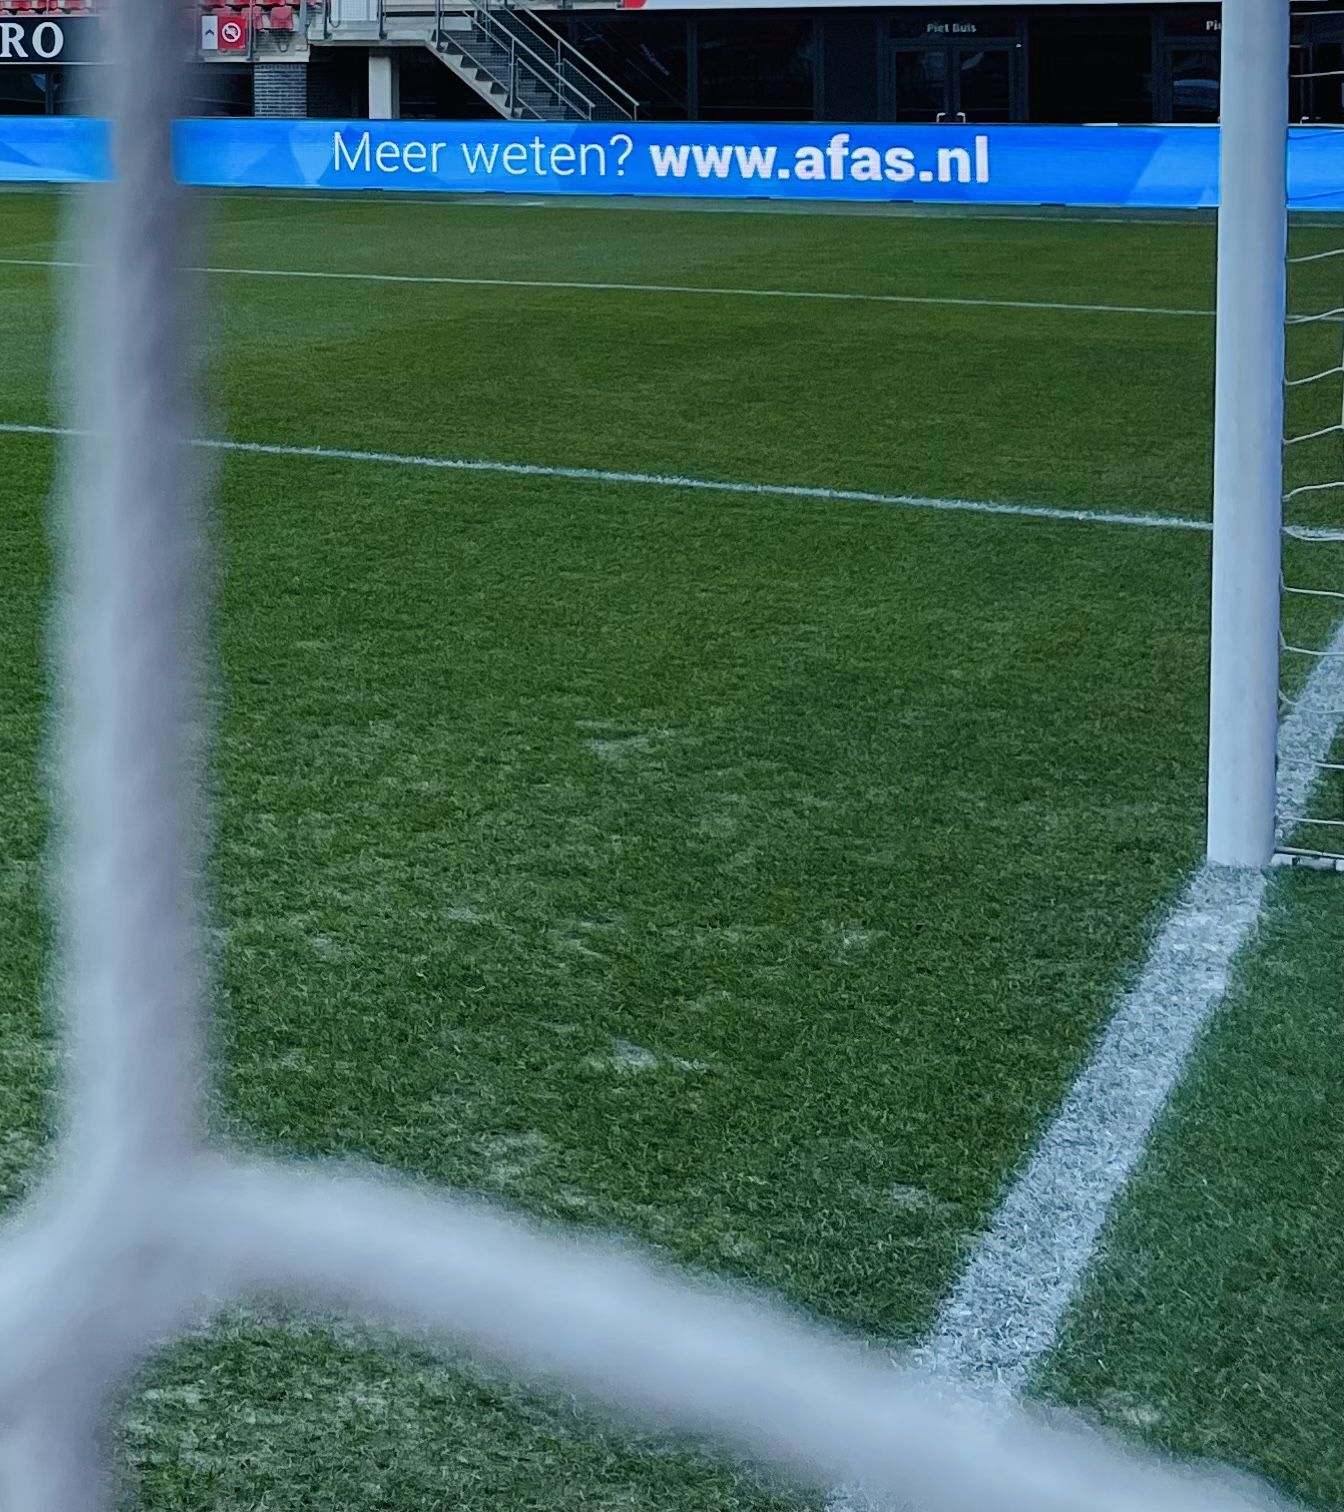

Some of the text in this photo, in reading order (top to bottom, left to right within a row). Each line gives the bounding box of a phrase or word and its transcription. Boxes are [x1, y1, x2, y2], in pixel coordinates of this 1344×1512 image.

[332, 131, 990, 184] Meer weten? www.afas.nl
